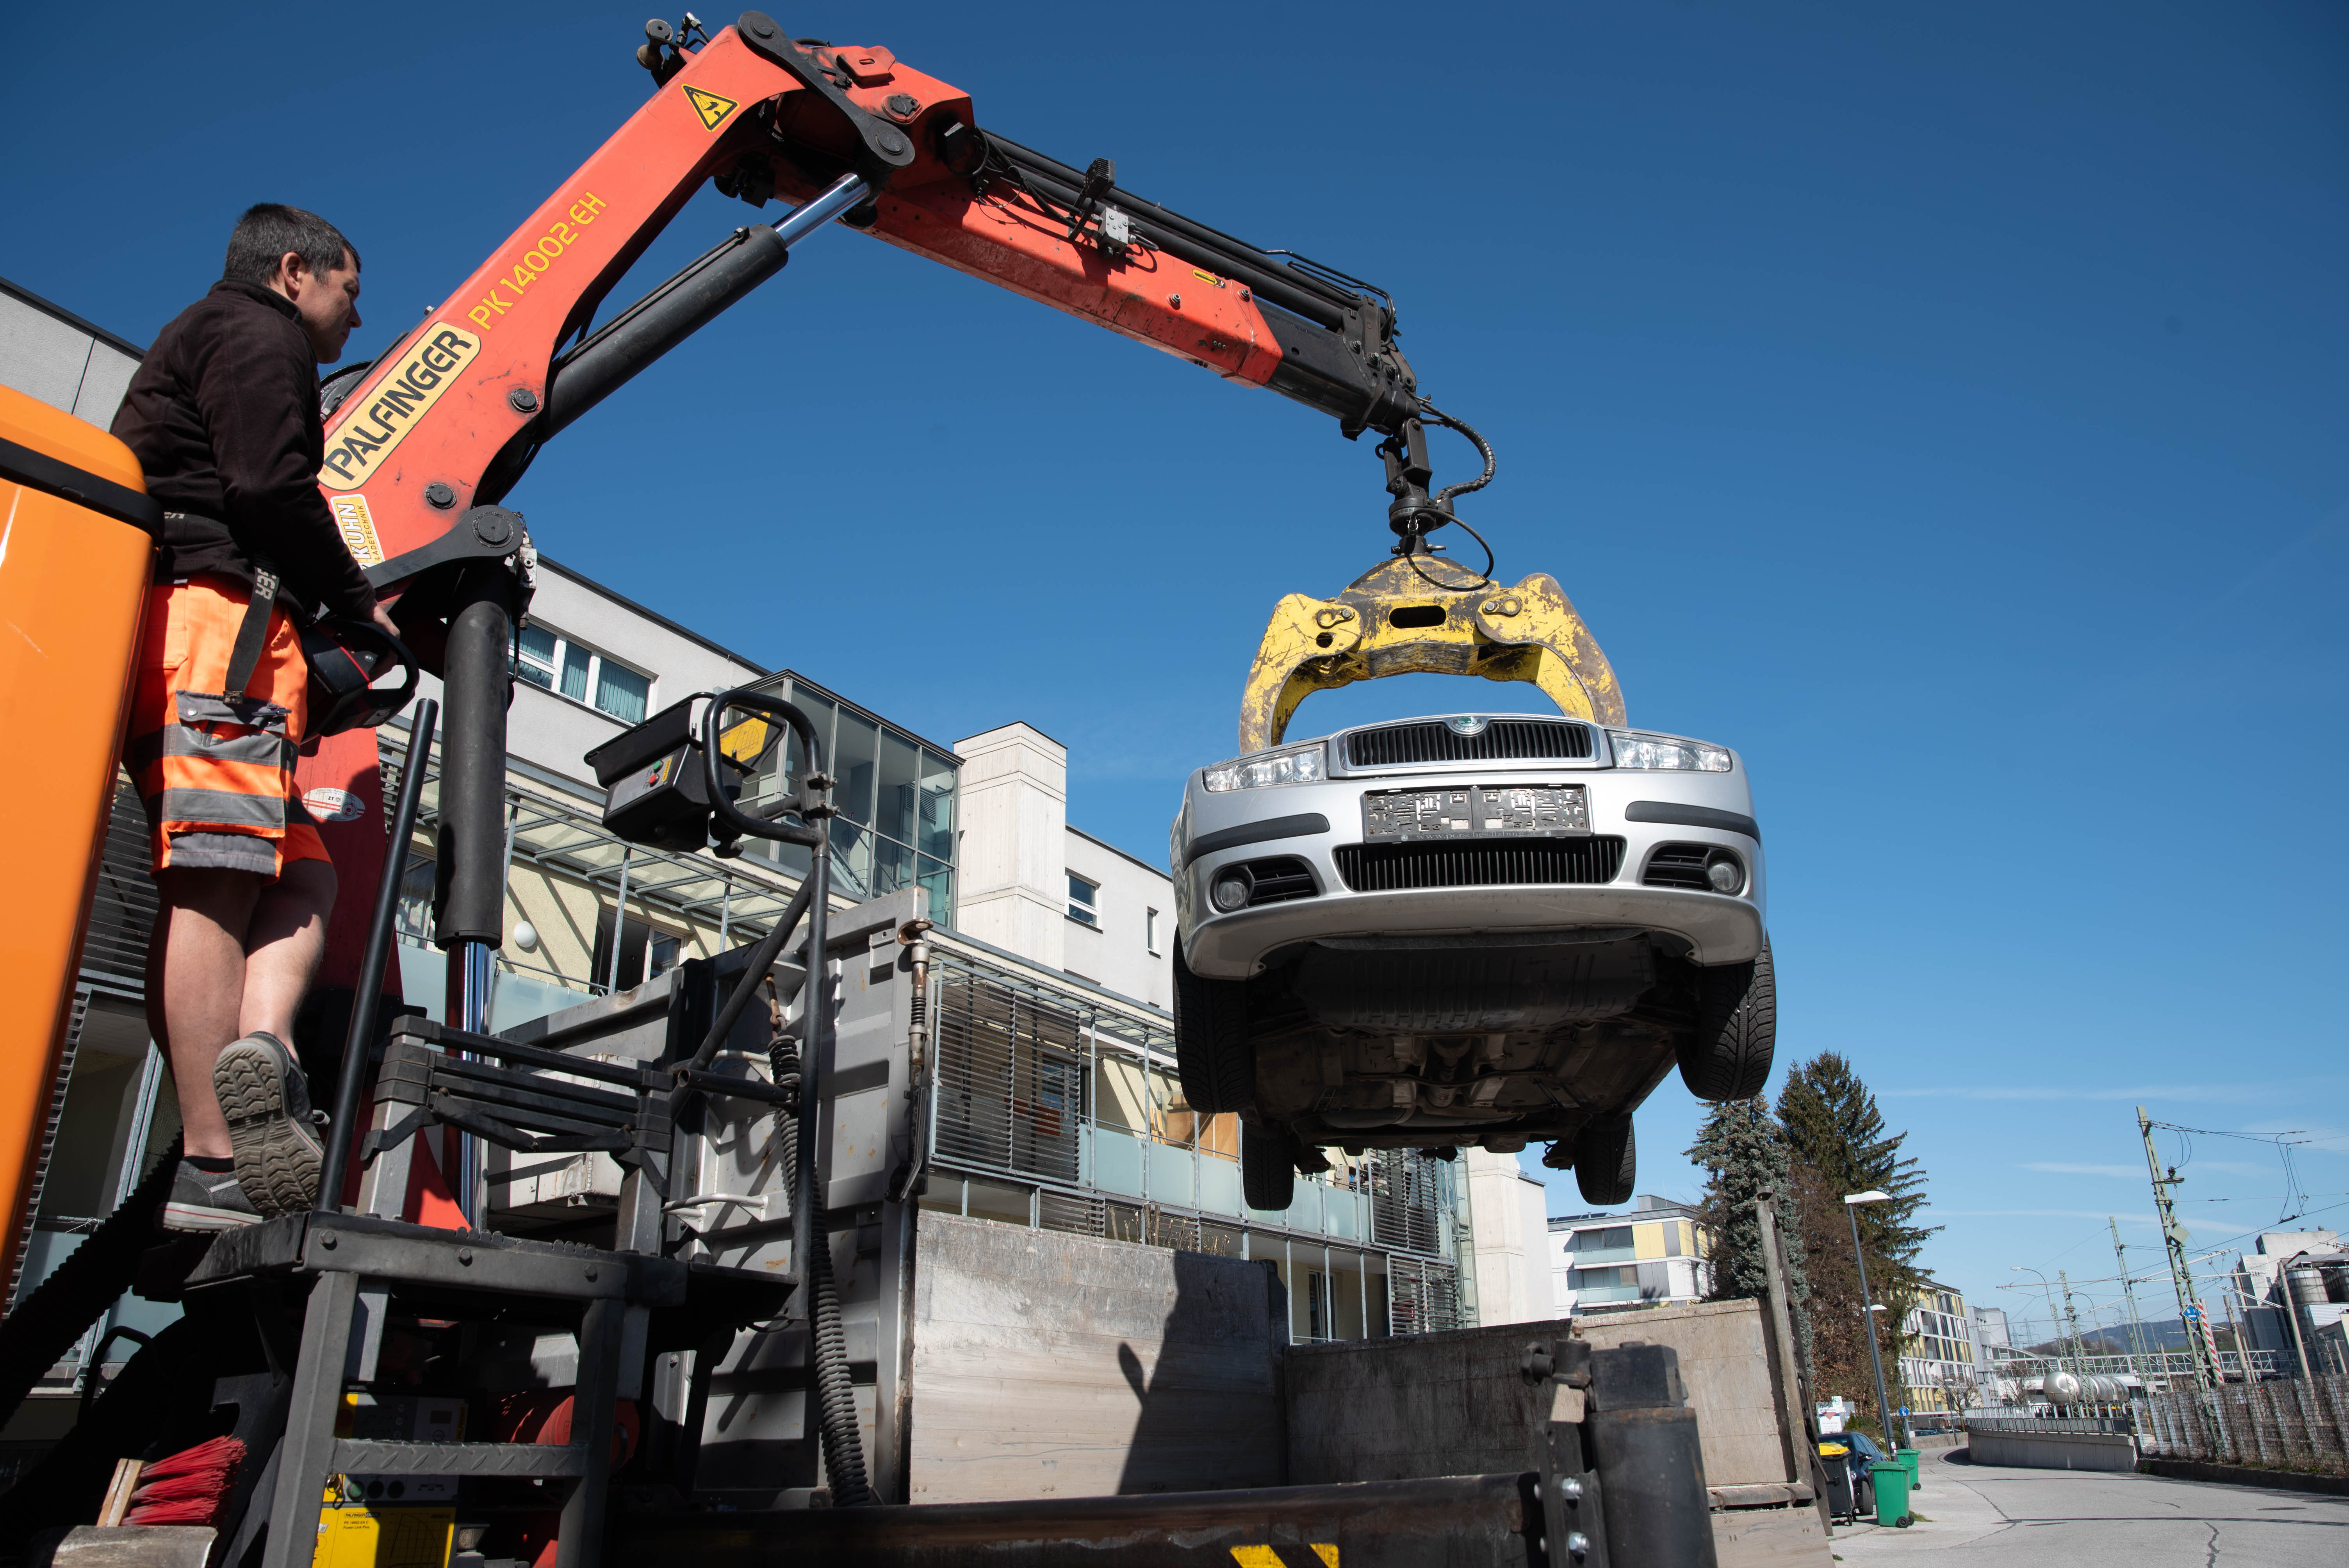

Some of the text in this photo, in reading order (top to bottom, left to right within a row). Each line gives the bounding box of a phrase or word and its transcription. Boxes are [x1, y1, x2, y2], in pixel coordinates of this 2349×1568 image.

[467, 288, 514, 331] PK
[323, 330, 472, 481] PALFINGER
[336, 503, 371, 559] KUHN
[356, 505, 380, 560] LADETECHNIK
